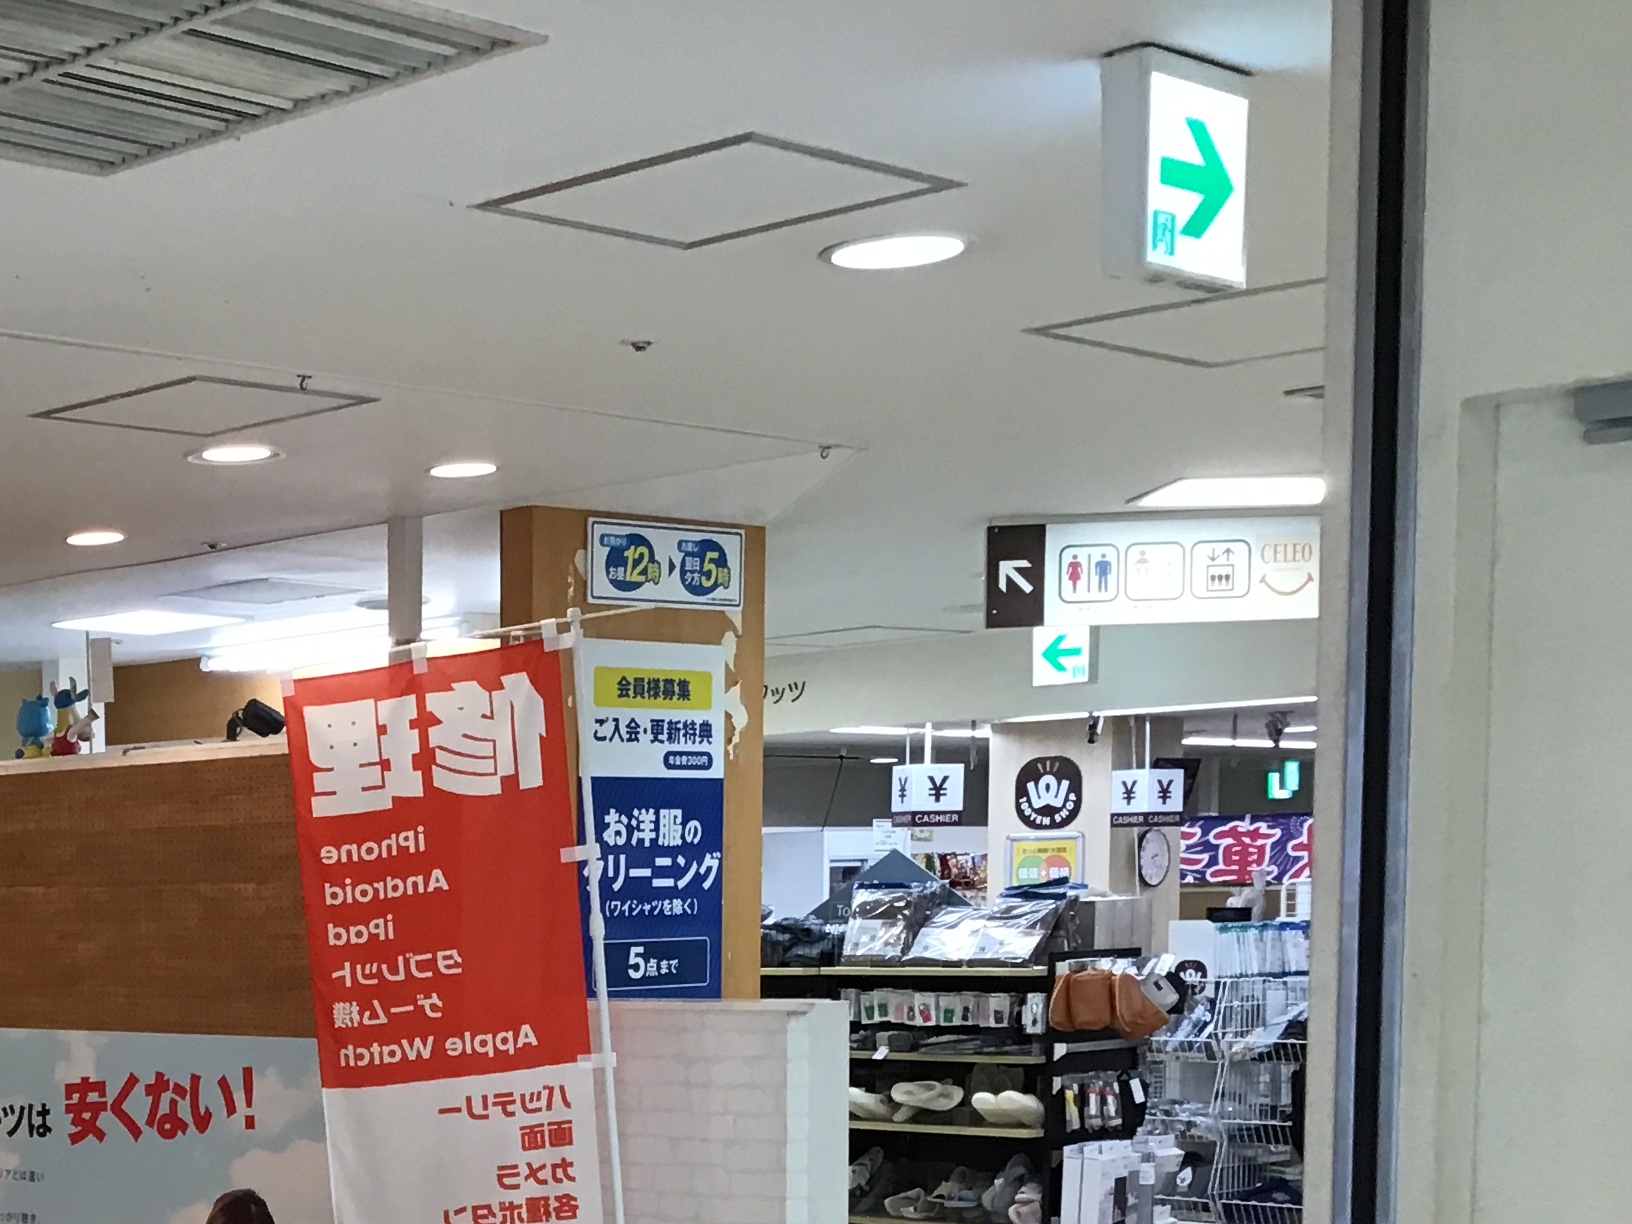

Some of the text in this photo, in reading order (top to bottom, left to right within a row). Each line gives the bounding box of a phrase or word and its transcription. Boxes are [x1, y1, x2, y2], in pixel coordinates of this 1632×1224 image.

[1260, 542, 1313, 565] CELEO
[616, 676, 691, 701] 会員様募集
[593, 716, 713, 745] ご入会・更新特典
[915, 813, 959, 825] CASHIER
[1019, 792, 1077, 826] 100YEN SHOP
[1112, 815, 1145, 825] CASHIER
[1148, 815, 1180, 825] CASHIER
[603, 808, 702, 847] お洋服の
[605, 898, 698, 917] (ワイシャツを除く)
[65, 1066, 256, 1145] 安くない!
